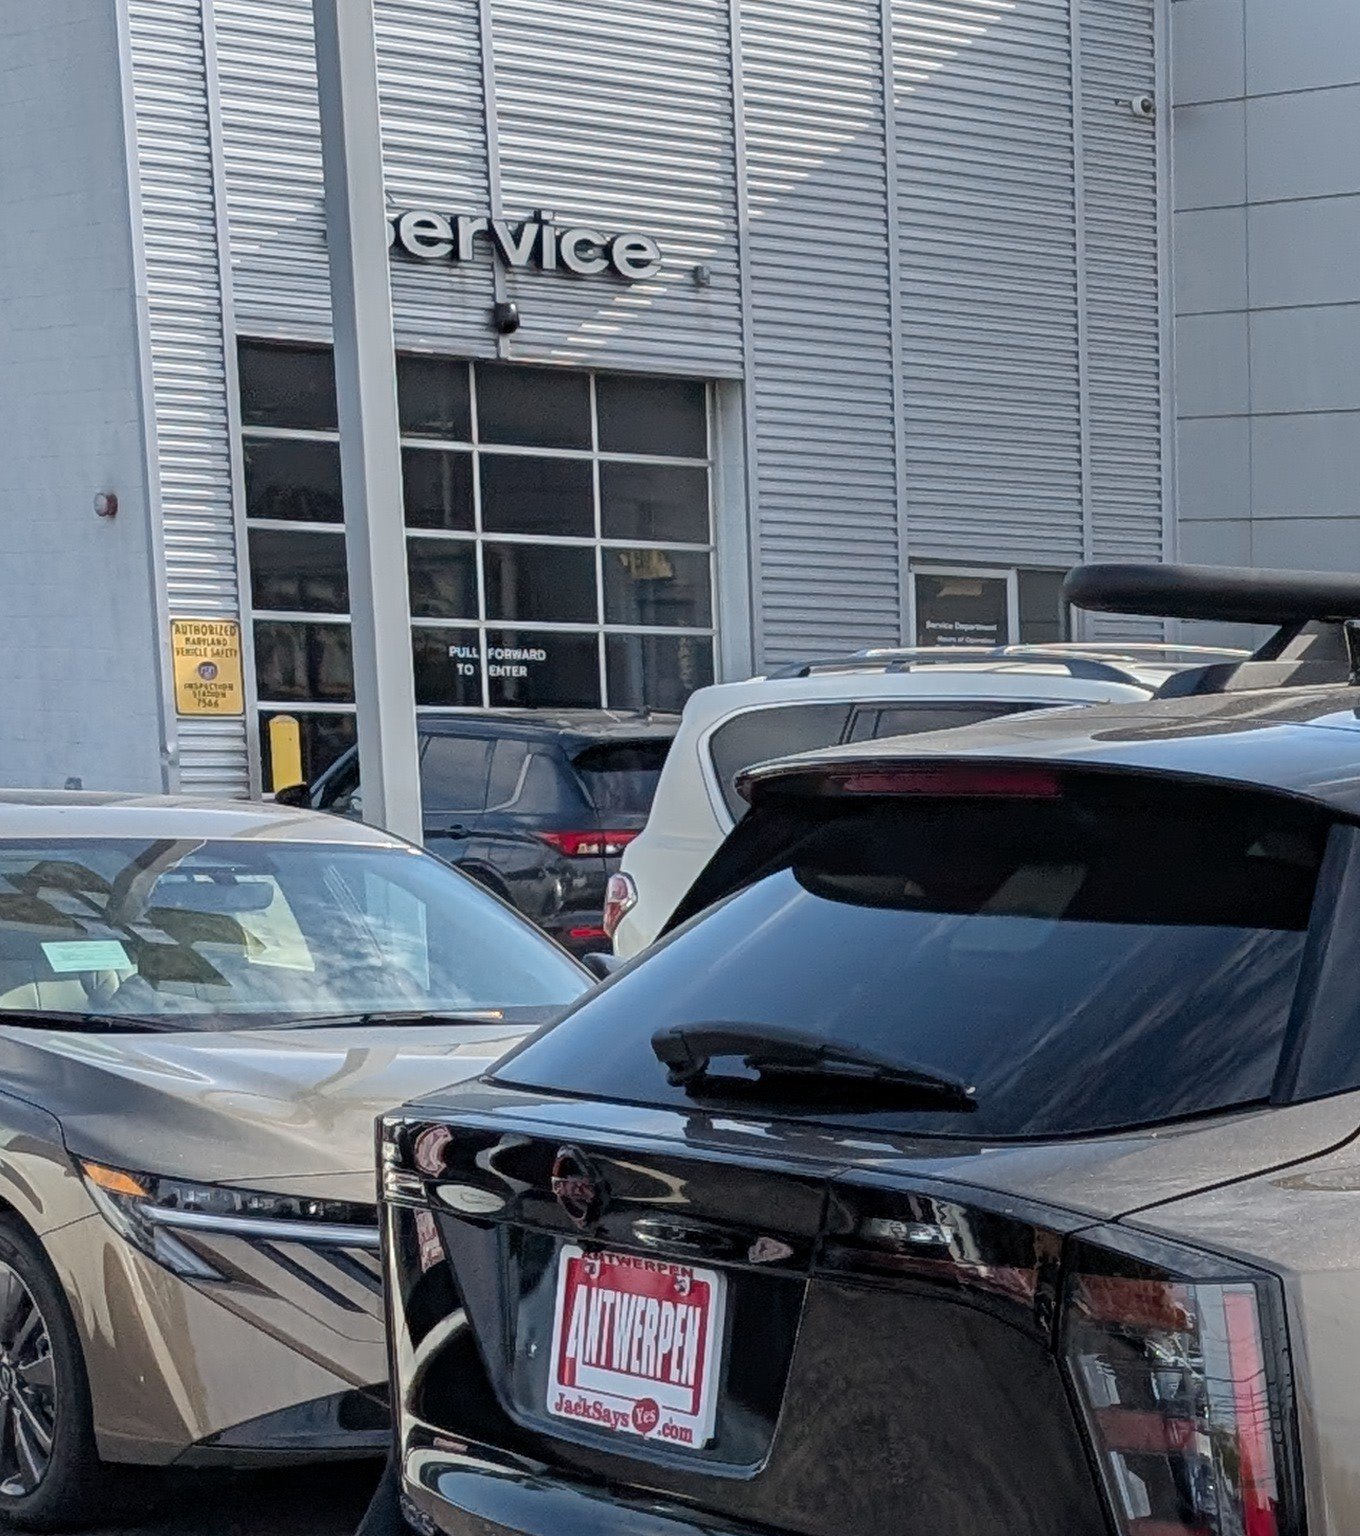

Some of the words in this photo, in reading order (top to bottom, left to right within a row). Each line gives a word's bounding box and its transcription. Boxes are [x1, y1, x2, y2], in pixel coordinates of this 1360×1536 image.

[387, 210, 662, 279] ervice
[174, 624, 237, 637] AUTHORIZED
[448, 645, 480, 659] PULL
[487, 647, 547, 661] FORWARD
[456, 663, 475, 676] TO
[488, 665, 528, 677] ENTER
[581, 1252, 694, 1278] ANTWERPEN
[565, 1284, 701, 1386] ANTWERPEN
[554, 1392, 630, 1431] JackSays
